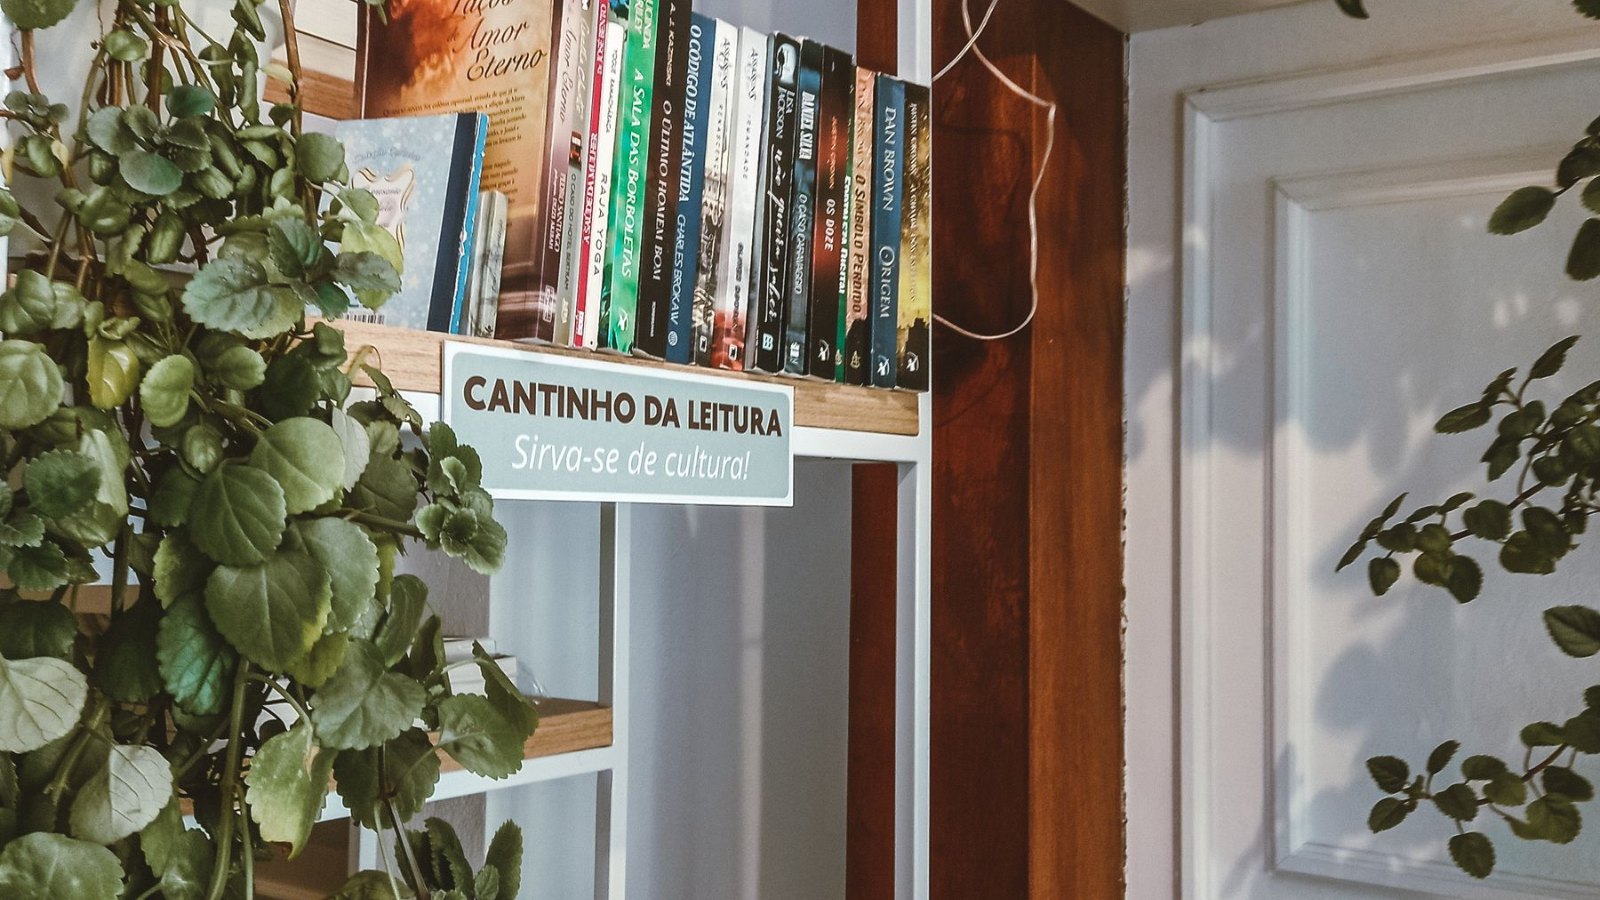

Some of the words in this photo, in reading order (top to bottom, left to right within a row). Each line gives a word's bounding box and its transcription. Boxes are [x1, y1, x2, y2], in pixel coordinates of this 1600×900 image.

[452, 17, 529, 53] Amor
[598, 4, 607, 39] BENTO
[643, 0, 653, 48] UCINDA
[690, 24, 702, 39] O
[466, 47, 548, 81] Eterno
[634, 68, 644, 81] A
[685, 40, 702, 98] CÓDIGO
[560, 71, 573, 122] Eterno
[631, 86, 645, 127] SALA
[662, 100, 672, 115] O
[684, 99, 697, 120] DE
[776, 86, 787, 138] JACKSON
[785, 89, 795, 114] LISA
[801, 91, 815, 130] DANIEL
[799, 131, 814, 160] SILVA
[884, 107, 897, 145] DAN
[628, 132, 640, 165] DAS
[678, 121, 695, 202] ATLÂNTIDA
[571, 173, 577, 181] O
[586, 181, 594, 197] DA
[597, 173, 607, 218] RAJA
[855, 175, 866, 186] O
[883, 150, 896, 212] BROWN
[568, 207, 575, 221] DO
[621, 168, 639, 278] BORBOLETAS
[655, 180, 667, 240] HOMEM
[797, 204, 807, 232] CASO
[826, 198, 836, 216] OS
[553, 205, 564, 253] SANTIAGO
[674, 214, 686, 268] CHARLES
[824, 218, 836, 252] DOZE
[594, 229, 604, 275] YOGA
[652, 244, 663, 281] BOM
[795, 233, 806, 295] CARAVAGGIO
[670, 269, 683, 325] BROKAW
[852, 252, 865, 313] PERDIDO
[878, 245, 896, 318] ORIGEM
[463, 375, 636, 424] CANTINHO
[644, 395, 680, 428] DA
[687, 400, 783, 437] LEITURA
[511, 434, 619, 473] Sirva-se
[628, 441, 655, 475] de
[664, 445, 751, 480] cultura!
